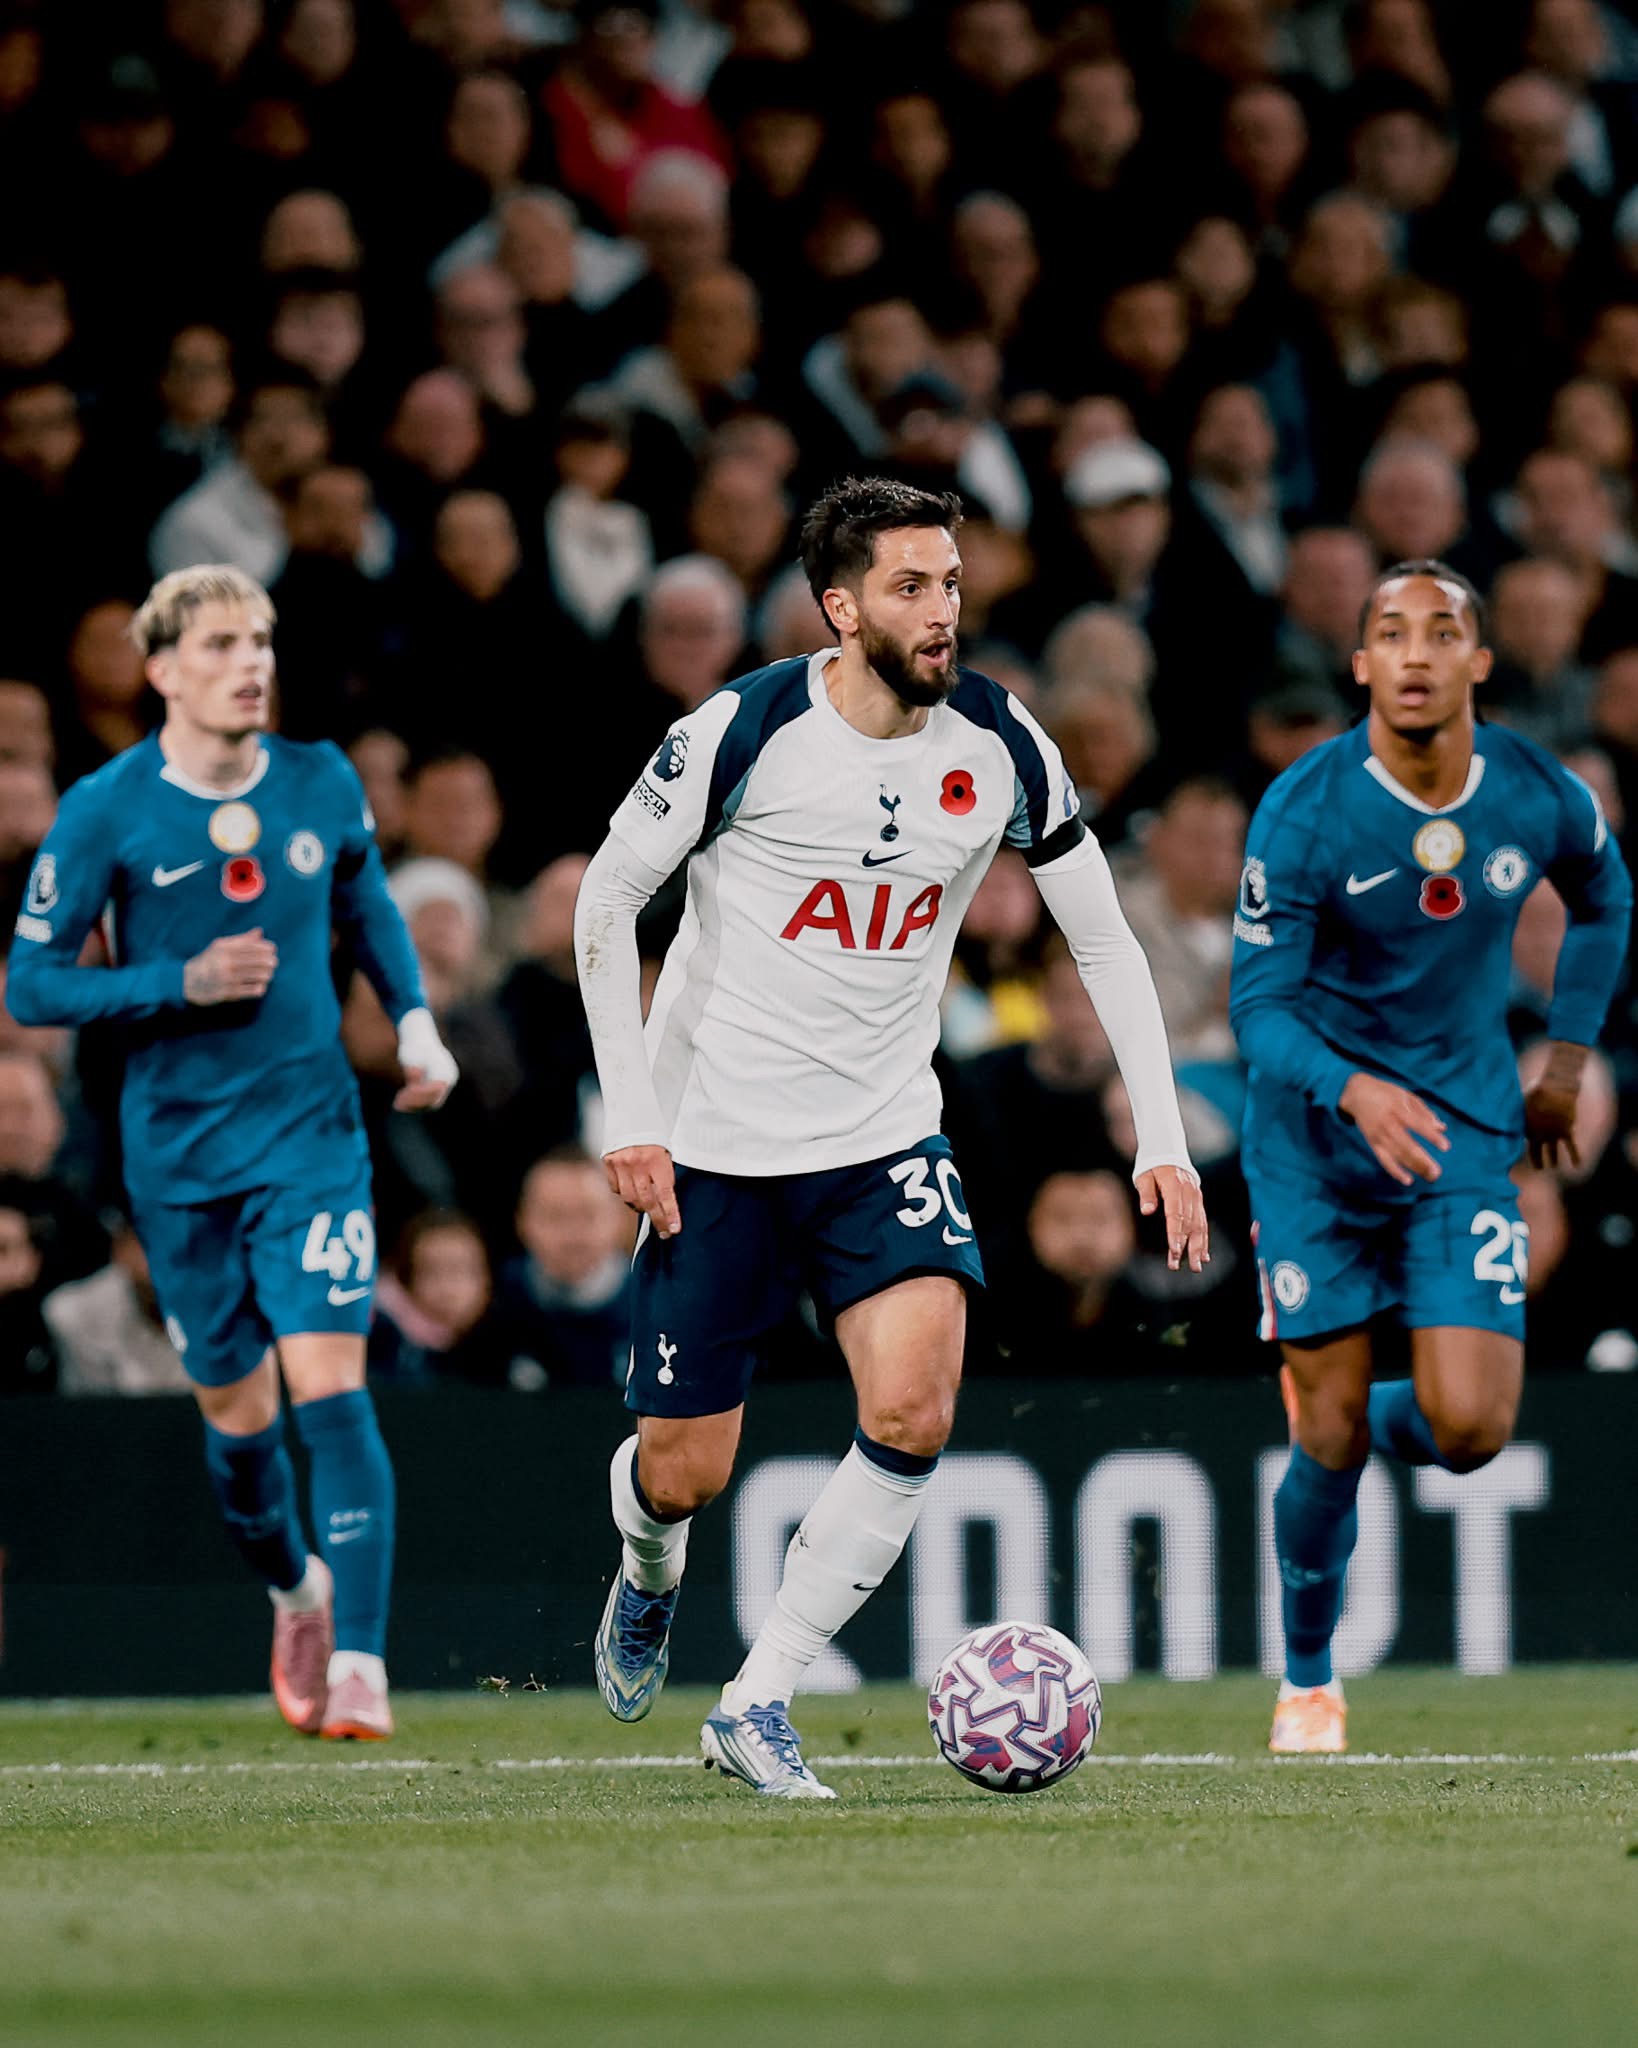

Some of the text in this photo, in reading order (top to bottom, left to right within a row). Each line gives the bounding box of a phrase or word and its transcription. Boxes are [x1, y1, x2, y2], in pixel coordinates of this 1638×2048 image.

[779, 879, 943, 950] AIA
[887, 1156, 972, 1231] 30
[301, 1208, 375, 1282] 49
